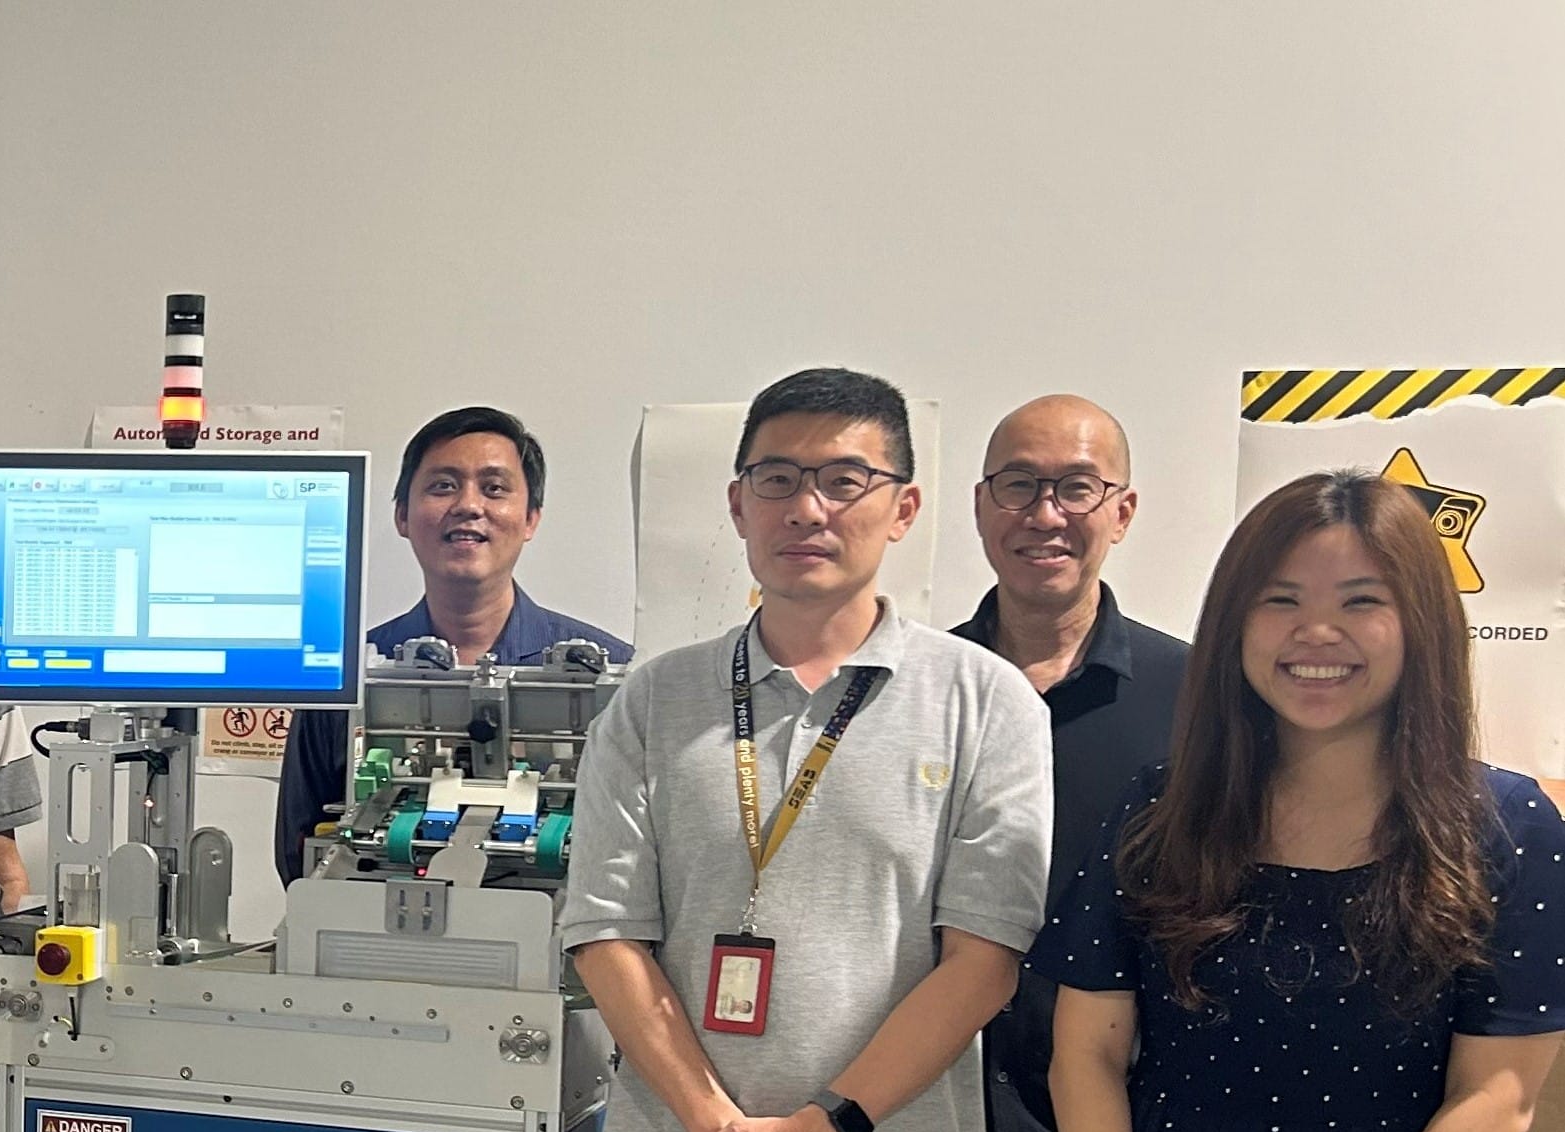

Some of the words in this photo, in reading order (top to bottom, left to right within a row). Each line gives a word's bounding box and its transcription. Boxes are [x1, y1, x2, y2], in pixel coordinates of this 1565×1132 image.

[113, 427, 210, 441] Autod
[216, 427, 282, 445] Storage
[287, 427, 320, 441] and
[299, 482, 317, 493] SP
[1468, 626, 1549, 641] CORDED
[734, 702, 749, 737] years
[739, 739, 756, 763] and
[739, 766, 757, 806] plenty
